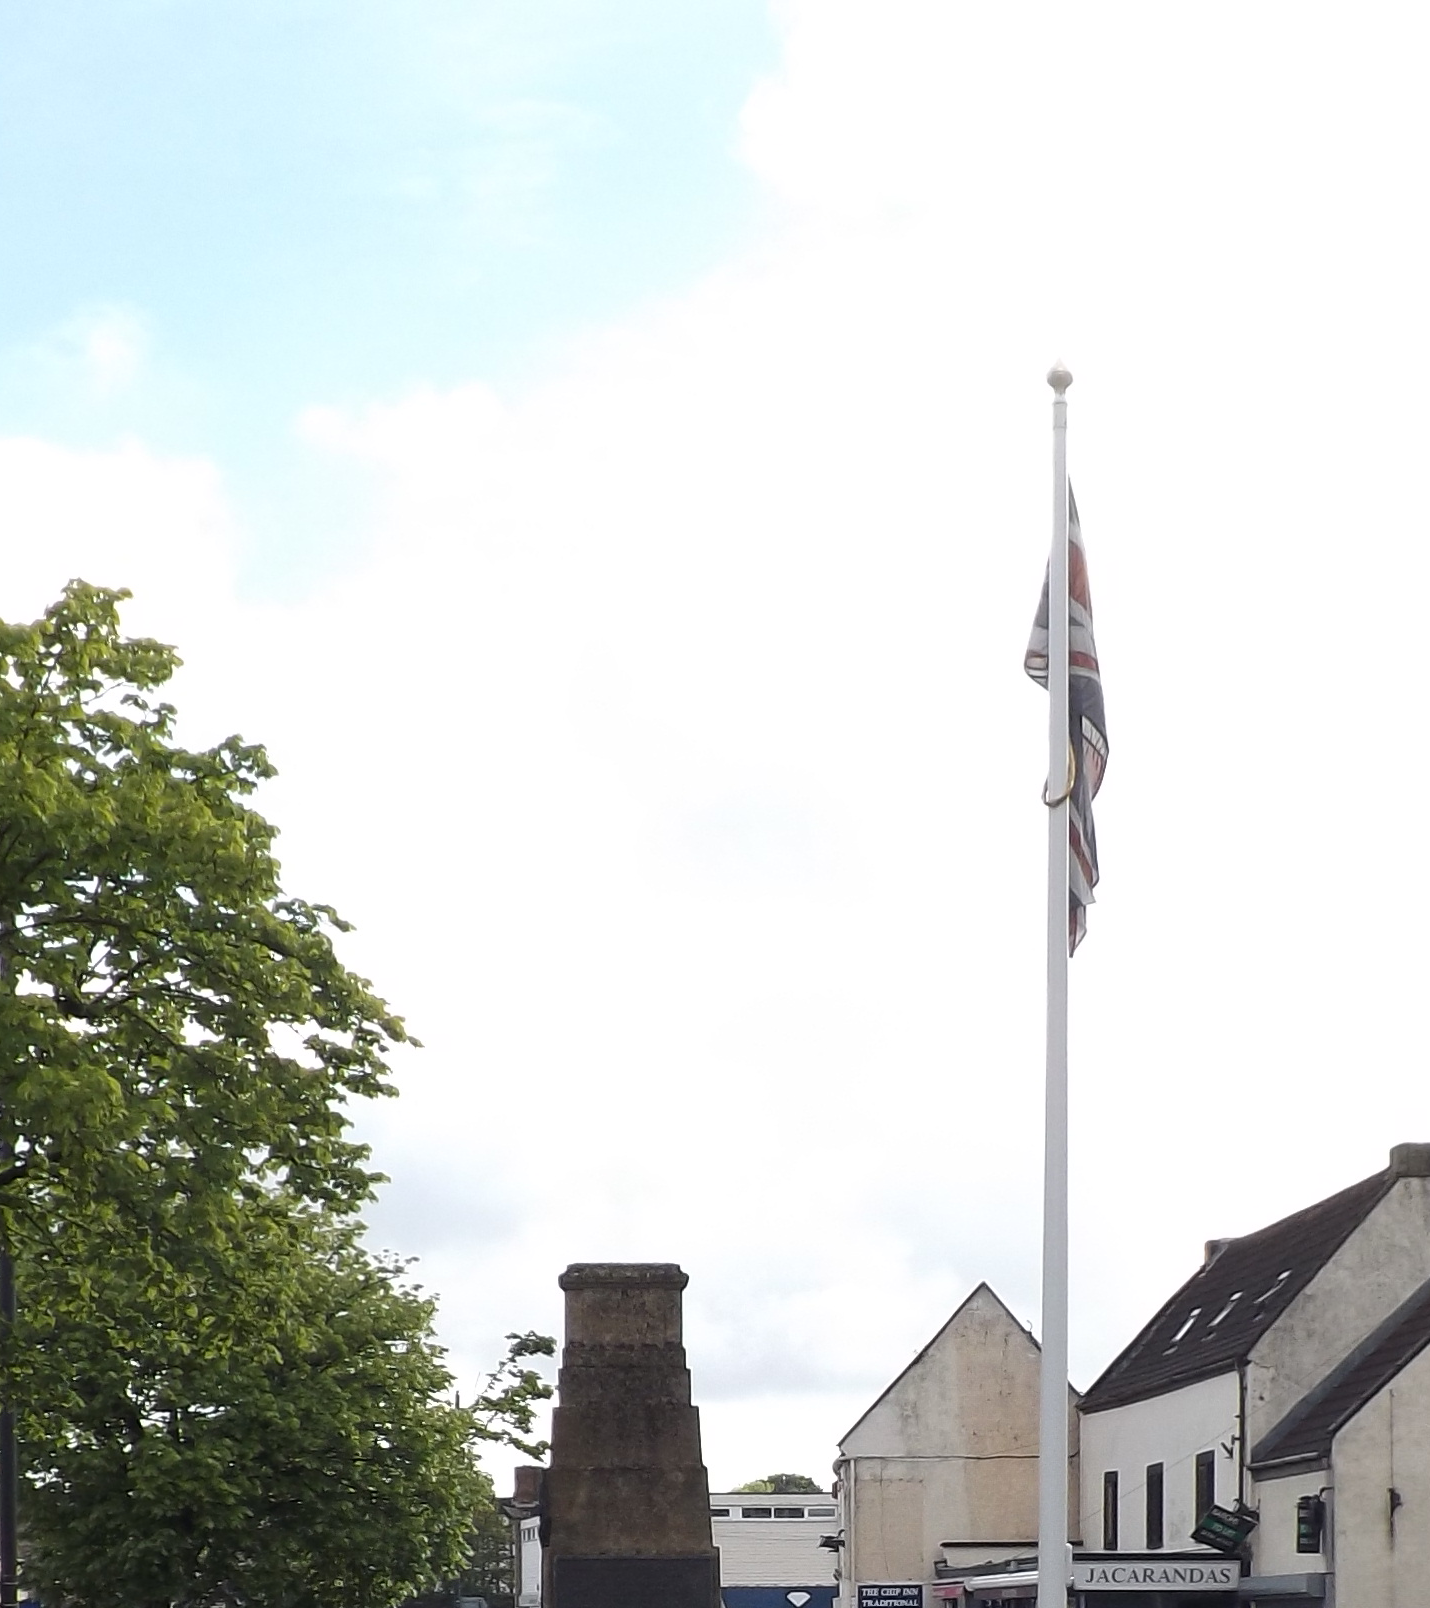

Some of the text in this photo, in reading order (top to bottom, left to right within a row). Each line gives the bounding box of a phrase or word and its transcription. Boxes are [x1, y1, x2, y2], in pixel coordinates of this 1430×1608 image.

[1085, 1567, 1232, 1585] JACARANDAS
[861, 1587, 880, 1597] THE
[861, 1599, 920, 1608] TRADITIONAL
